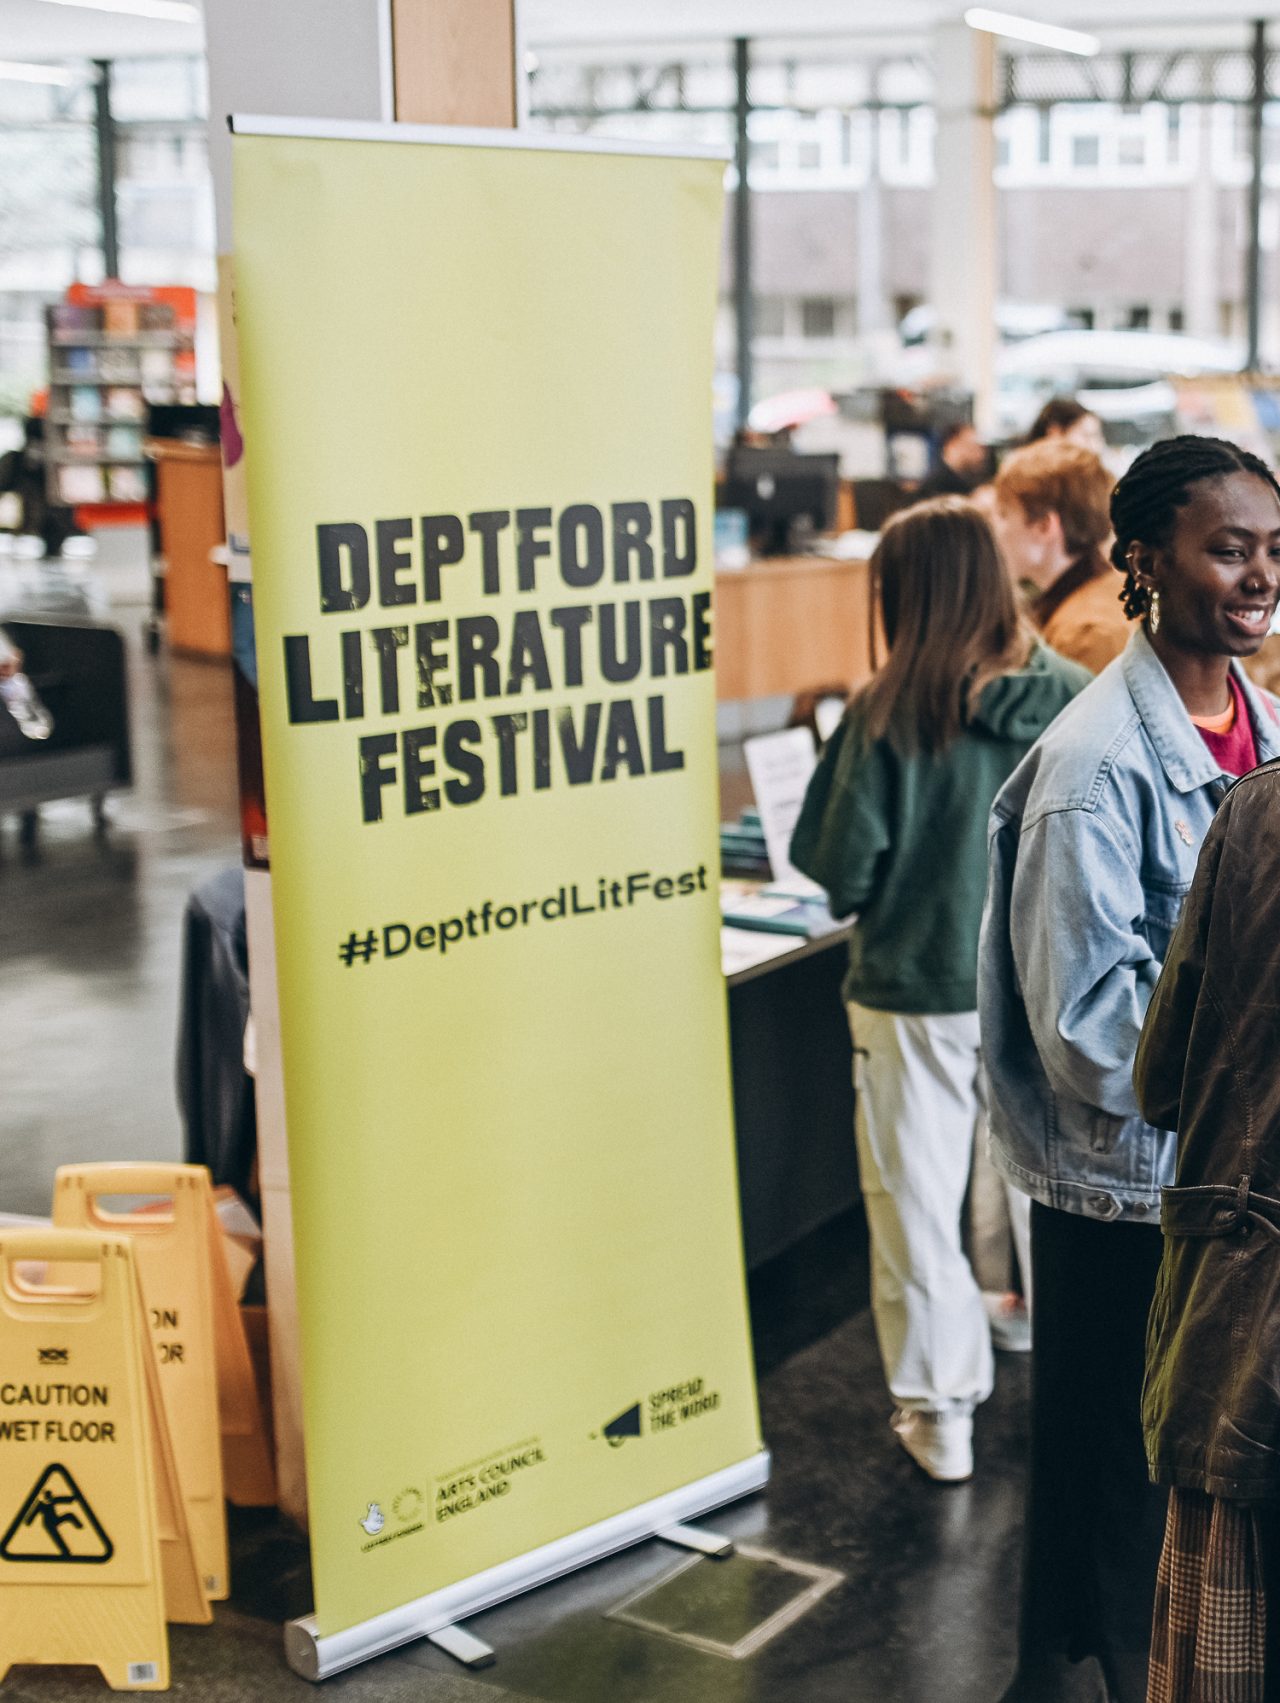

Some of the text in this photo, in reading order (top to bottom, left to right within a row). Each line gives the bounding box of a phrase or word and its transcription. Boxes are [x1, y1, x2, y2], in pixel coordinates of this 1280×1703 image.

[316, 498, 697, 615] DEPTFORD
[283, 591, 713, 726] LITERATURE
[358, 695, 685, 824] FESTIVAL
[338, 865, 708, 967] #DeptfordLitFest
[1, 1383, 108, 1406] CAUTION
[45, 1420, 116, 1442] FLOOR
[435, 1481, 512, 1523] ENGLAND
[436, 1474, 477, 1502] ARTS
[478, 1447, 548, 1485] COUNCIL
